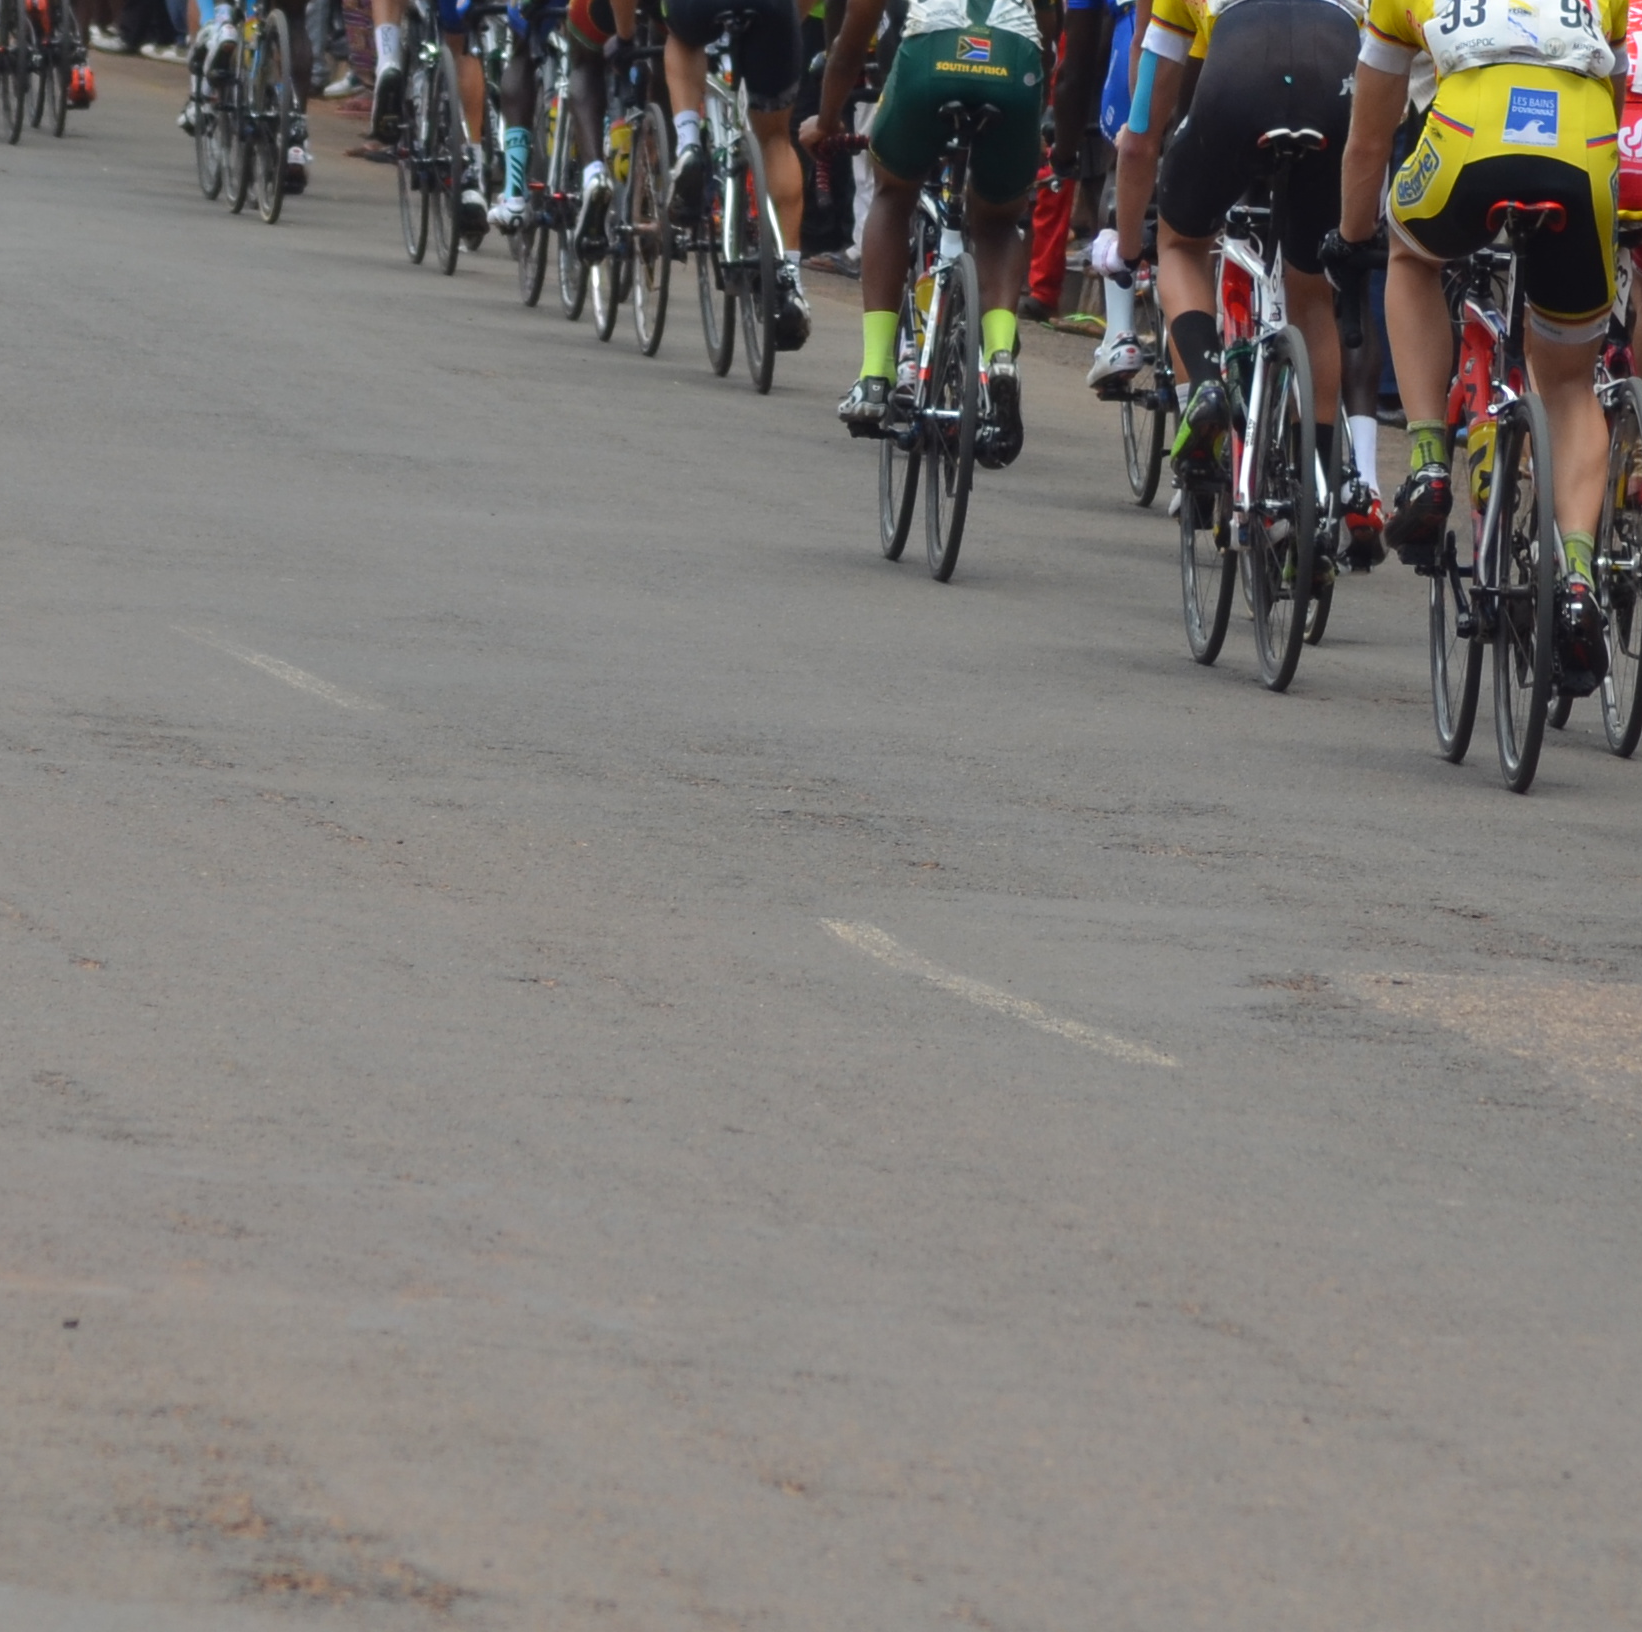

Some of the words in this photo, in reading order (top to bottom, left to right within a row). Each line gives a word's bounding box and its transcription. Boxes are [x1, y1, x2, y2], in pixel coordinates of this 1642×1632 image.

[935, 60, 970, 73] SOUTH
[970, 63, 1008, 77] AFRICA
[1512, 95, 1528, 107] LES
[1528, 96, 1555, 109] BAINS
